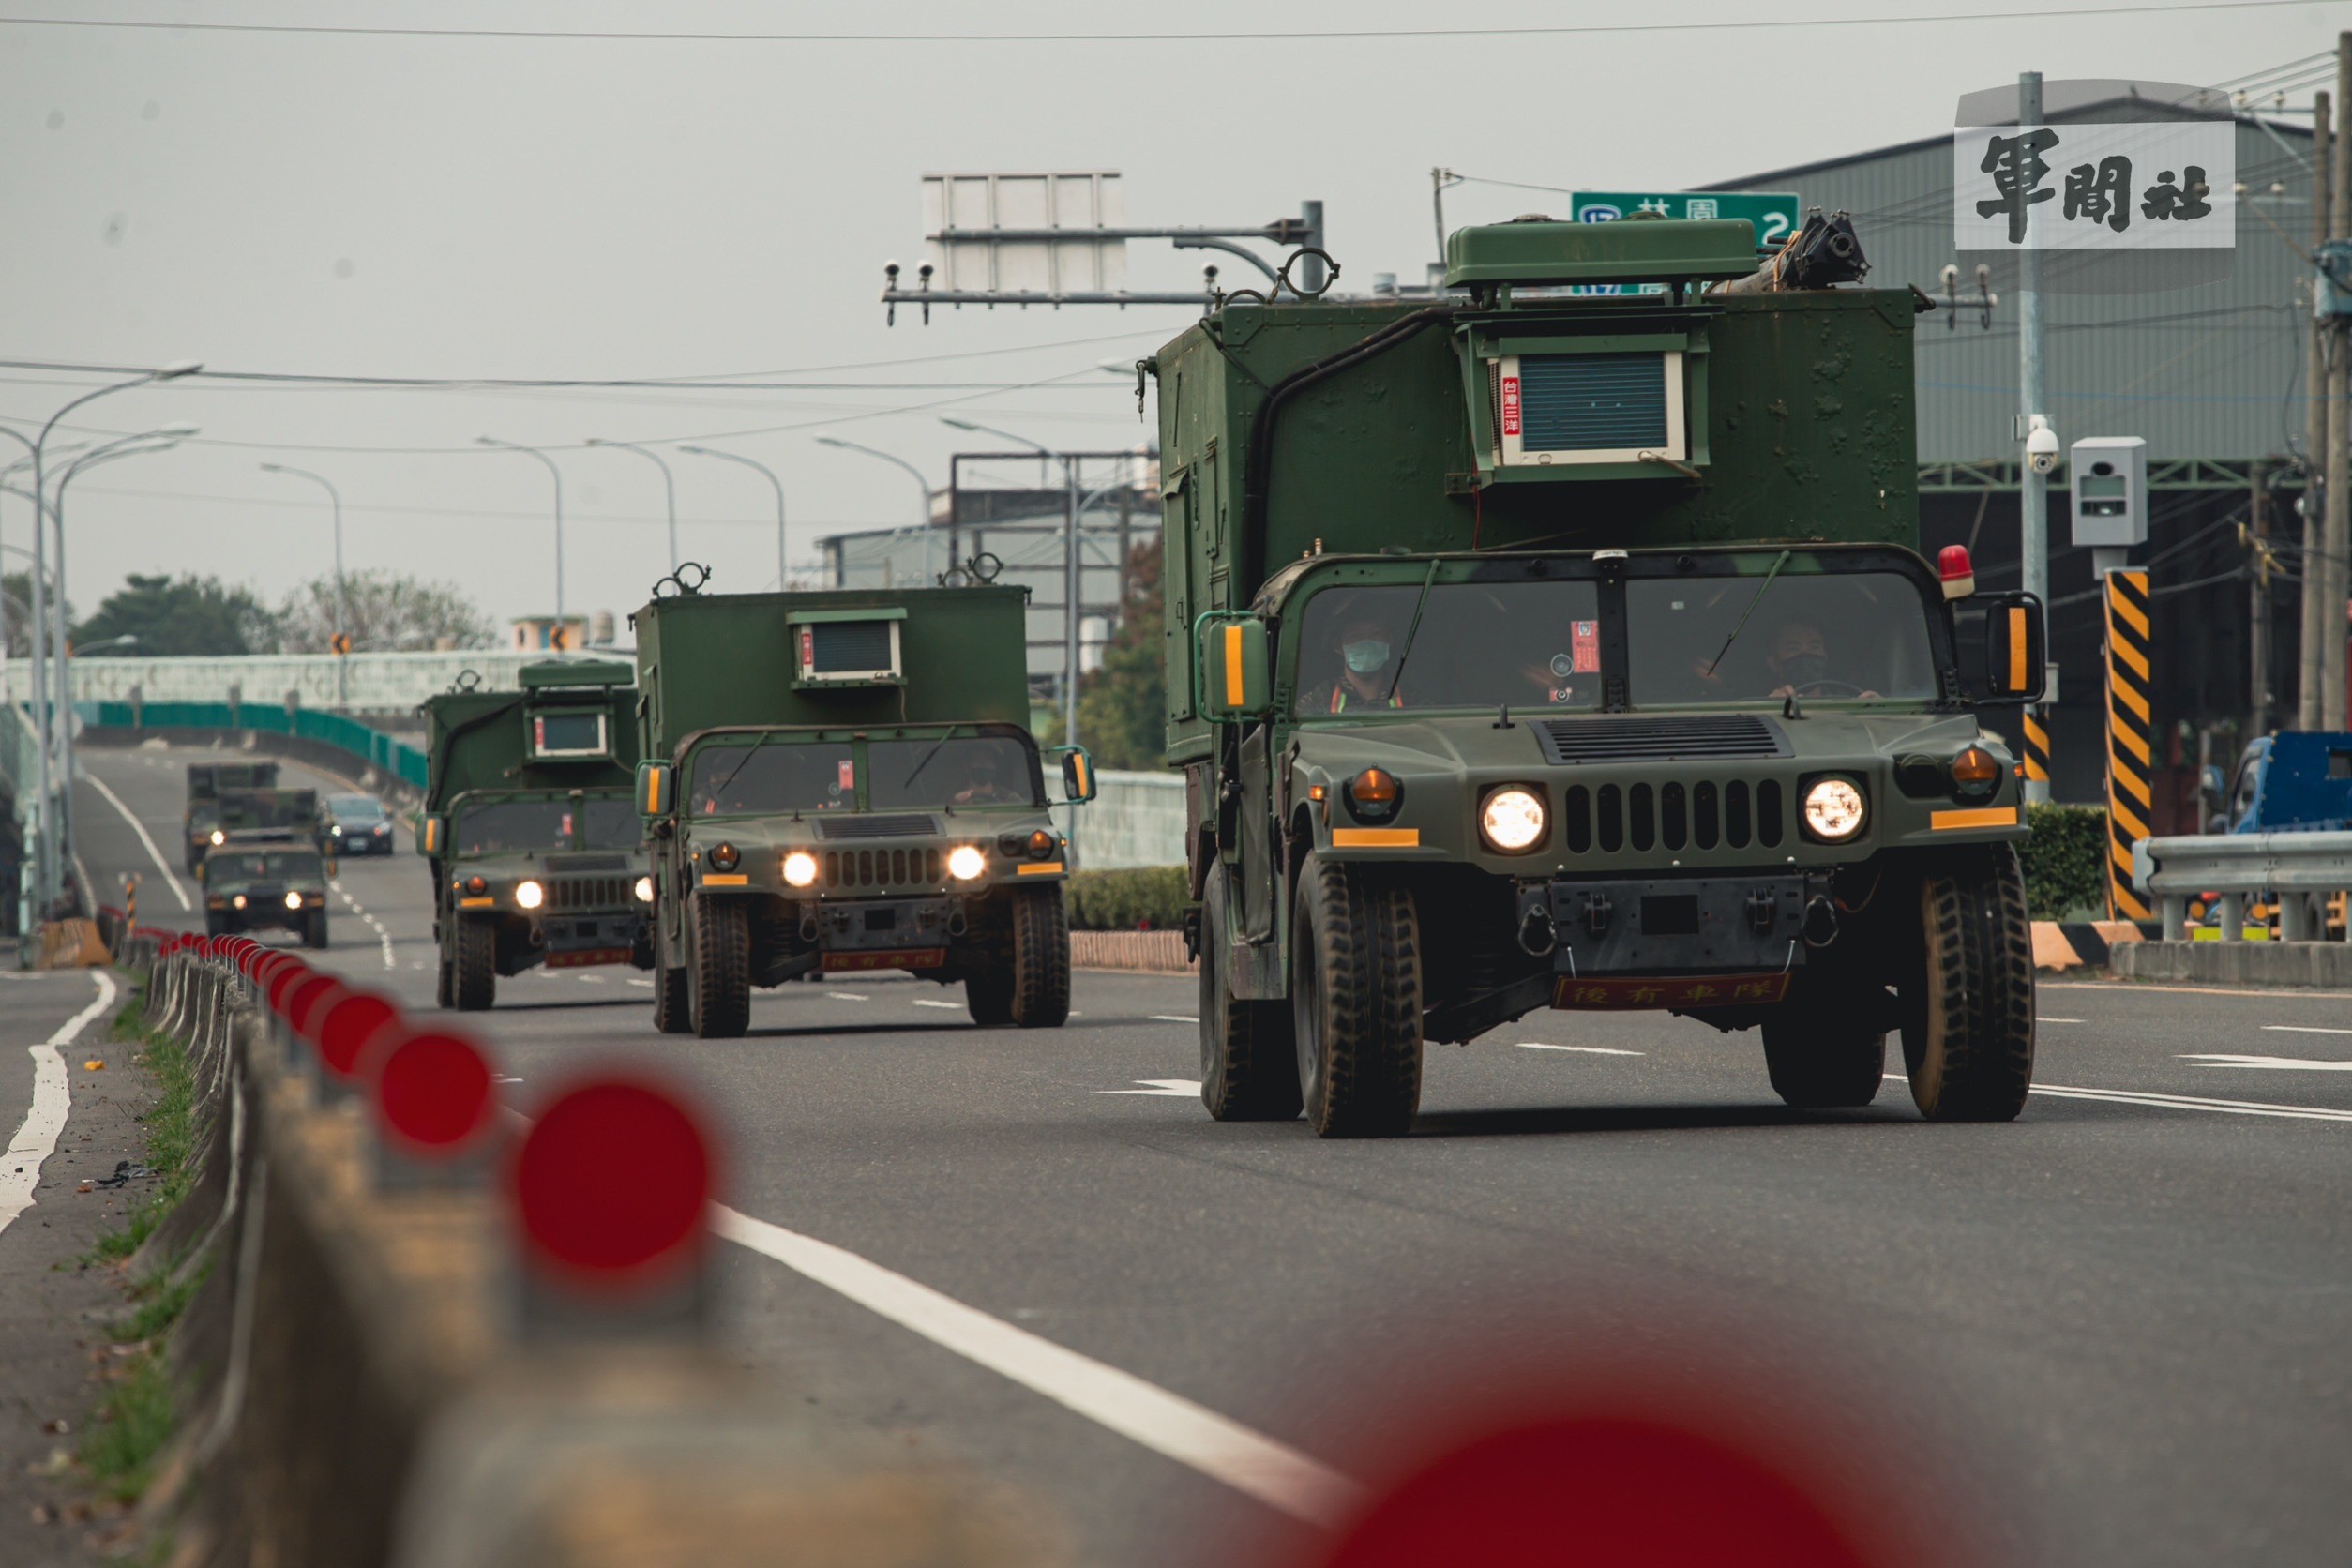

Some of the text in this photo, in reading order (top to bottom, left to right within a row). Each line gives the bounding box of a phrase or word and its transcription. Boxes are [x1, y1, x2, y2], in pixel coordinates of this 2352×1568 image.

[1504, 381, 1519, 431] 台灣三洋
[1575, 981, 1772, 1003] 後有車隊
